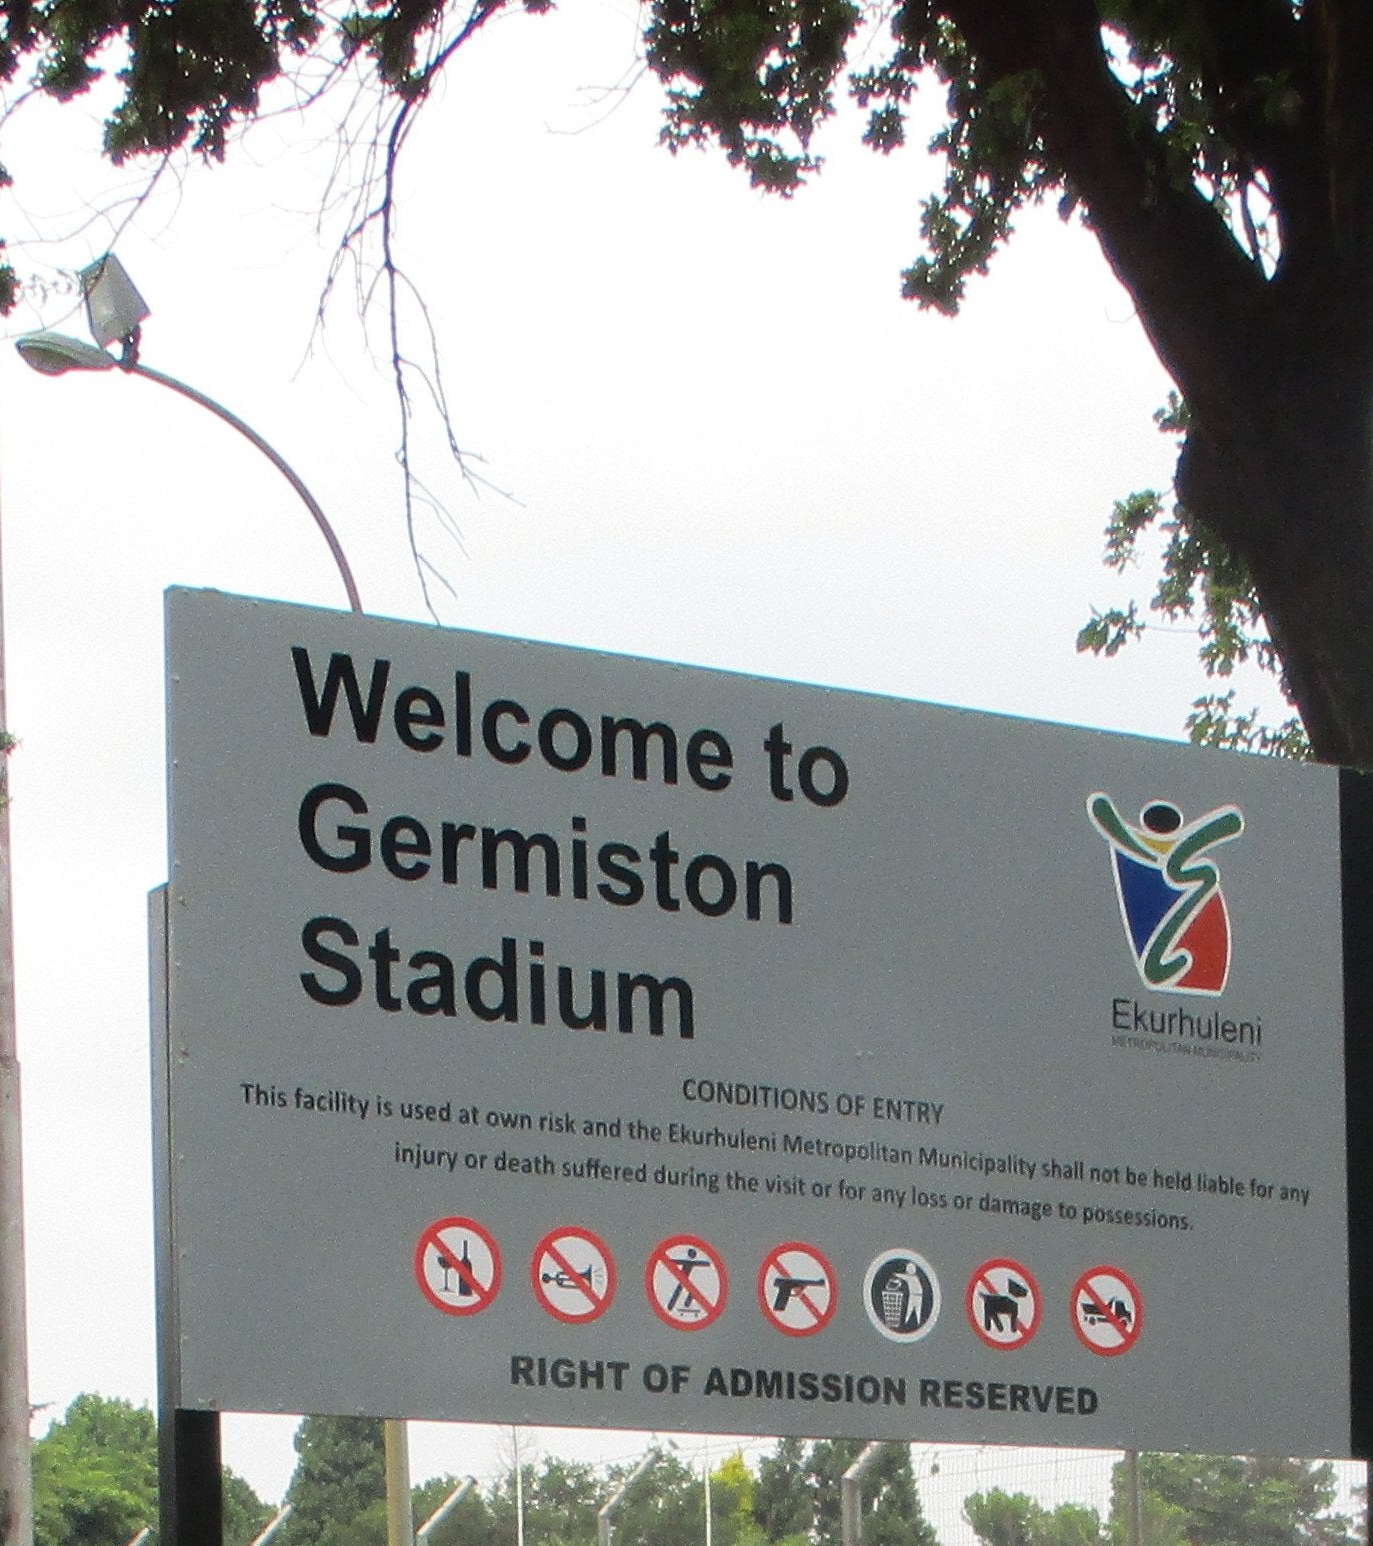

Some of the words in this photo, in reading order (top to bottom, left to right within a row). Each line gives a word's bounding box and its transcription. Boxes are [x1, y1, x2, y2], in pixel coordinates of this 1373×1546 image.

[290, 645, 735, 792] Welcome
[763, 722, 849, 808] to
[297, 781, 794, 925] Germiston
[299, 916, 695, 1040] Stadium
[1112, 997, 1262, 1046] Ekurhuleni
[240, 1083, 288, 1108] This
[294, 1086, 370, 1120] facility
[376, 1094, 393, 1118] is
[400, 1101, 452, 1123] used
[458, 1106, 479, 1126] at
[485, 1110, 533, 1130] own
[538, 1112, 576, 1134] risk
[582, 1117, 622, 1138] and
[627, 1119, 662, 1143] the
[668, 1123, 777, 1152] Ekurhuleni
[782, 1133, 913, 1165] Metropolitan
[918, 1146, 1037, 1181] Municipality
[1041, 1158, 1084, 1181] shall
[1089, 1167, 1121, 1185] not
[1125, 1166, 1148, 1187] be
[1153, 1168, 1193, 1192] held
[1196, 1173, 1245, 1197] liable
[1249, 1177, 1275, 1199] for
[1279, 1185, 1310, 1207] any
[682, 1078, 830, 1115] CONDITIONS
[835, 1093, 865, 1117] OF
[873, 1096, 944, 1125] ENTRY
[394, 1141, 459, 1173] injury
[464, 1153, 488, 1170] or
[493, 1150, 555, 1175] death
[562, 1157, 647, 1183] suffered
[653, 1164, 720, 1194] during
[725, 1170, 759, 1193] the
[765, 1174, 806, 1197] visit
[811, 1182, 833, 1198] or
[837, 1178, 866, 1201] for
[871, 1187, 907, 1209] any
[911, 1185, 949, 1209] loss
[952, 1194, 974, 1211] or
[978, 1192, 1053, 1222] damage
[1057, 1202, 1078, 1220] to
[1082, 1206, 1194, 1231] possessions.
[510, 1355, 630, 1391] RIGHT
[642, 1363, 691, 1394] OF
[703, 1367, 906, 1405] ADMISSION
[919, 1378, 1099, 1416] RESERVED
